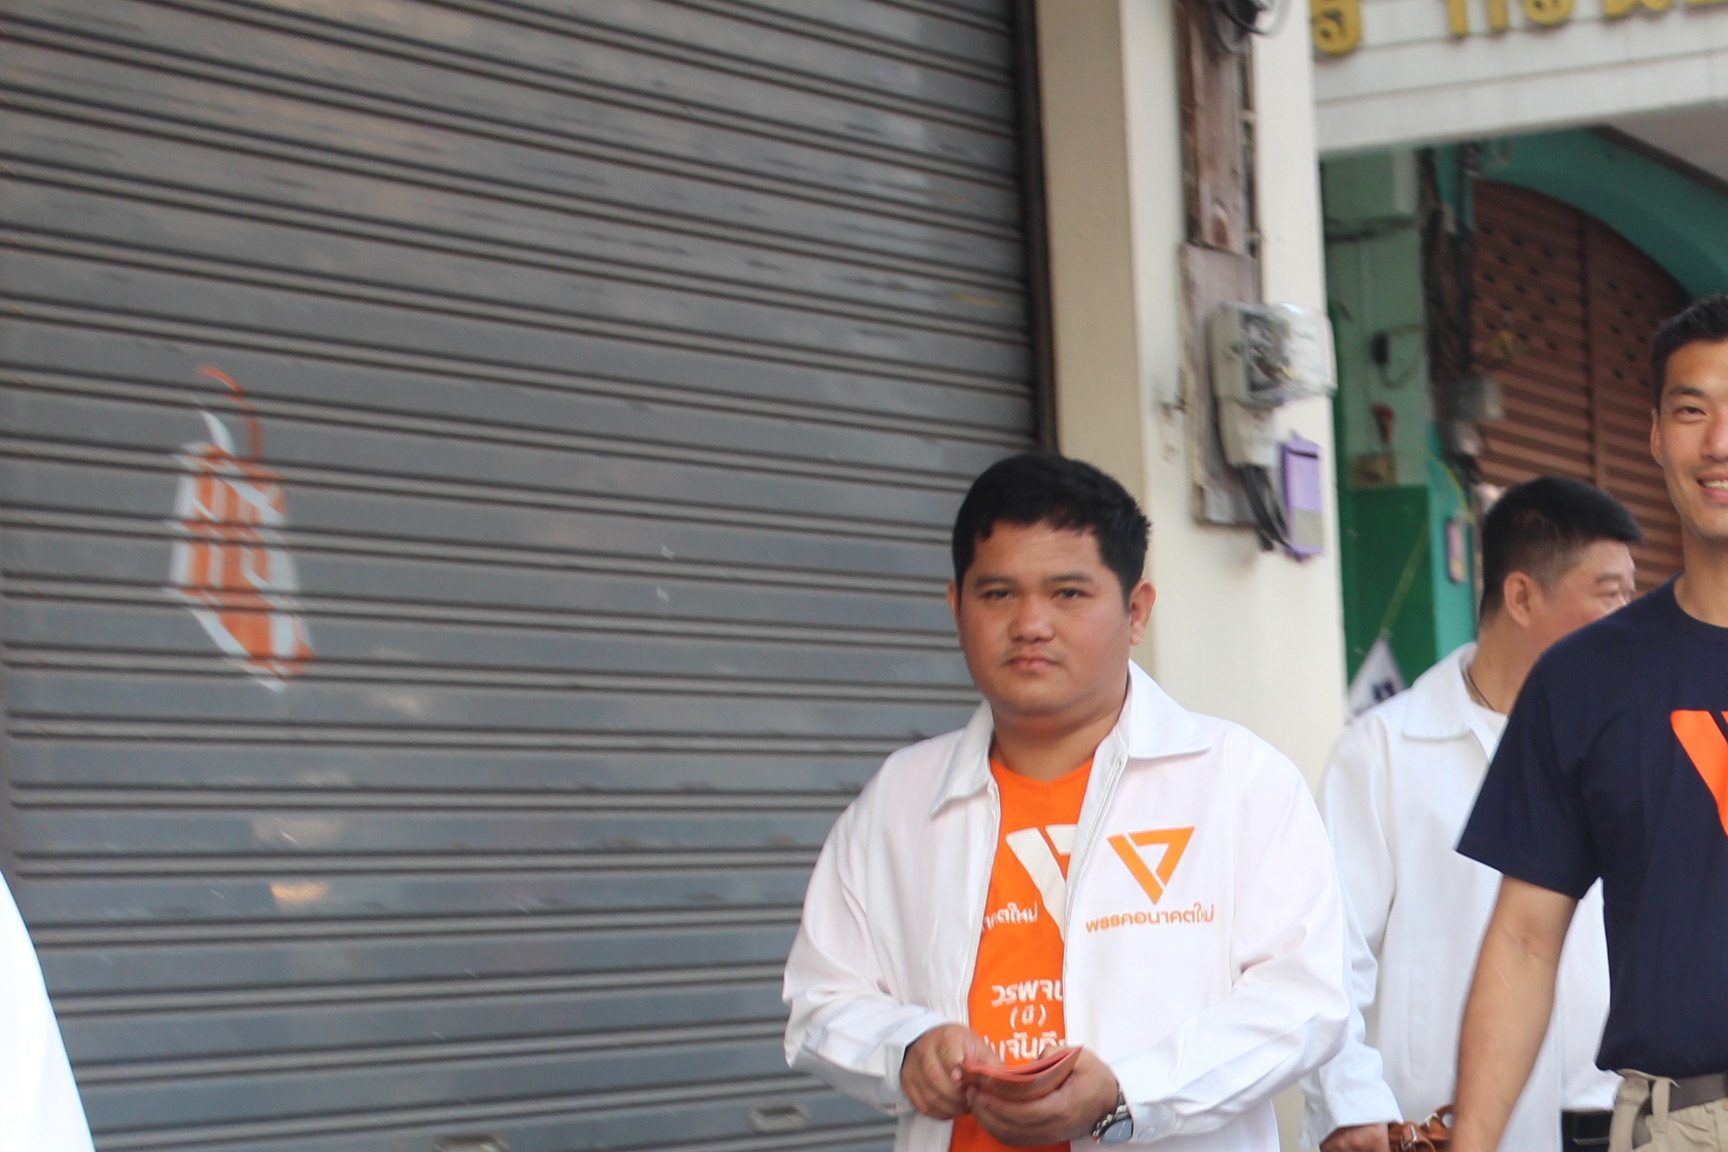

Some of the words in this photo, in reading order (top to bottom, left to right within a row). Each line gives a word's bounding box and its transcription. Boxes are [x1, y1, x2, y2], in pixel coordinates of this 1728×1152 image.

[1085, 902, 1216, 934] พรรคอนาคตใหม่
